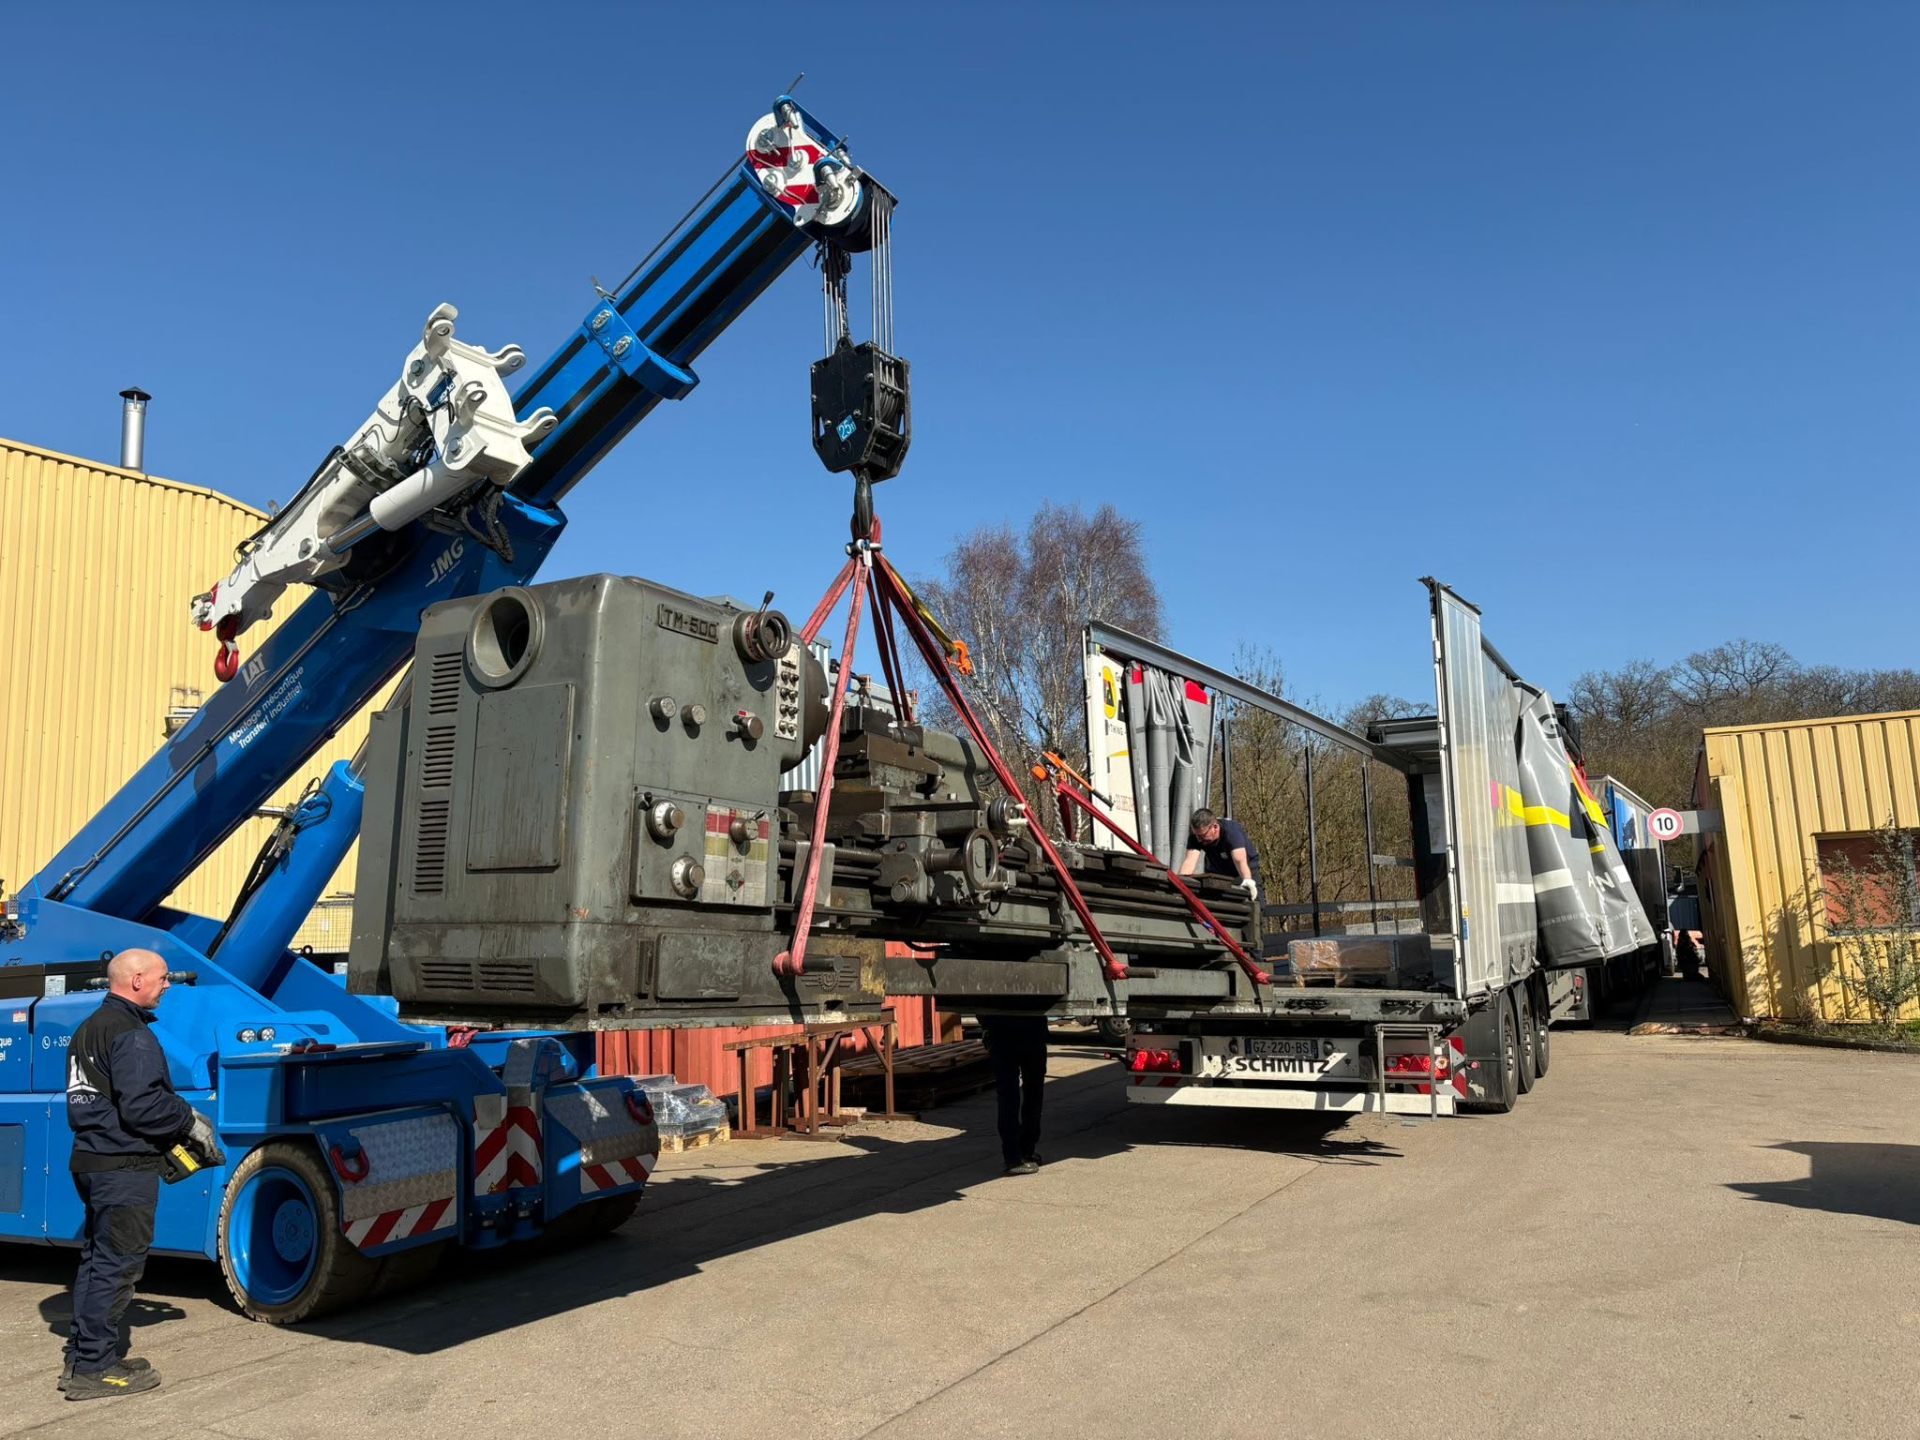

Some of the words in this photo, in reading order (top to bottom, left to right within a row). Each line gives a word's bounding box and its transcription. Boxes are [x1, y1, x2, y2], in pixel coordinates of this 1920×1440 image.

[663, 608, 718, 640] TM-500
[241, 652, 266, 687] LAT
[228, 709, 262, 745] Montage
[261, 665, 304, 712] mécanique
[238, 713, 270, 749] Transfert
[1656, 816, 1674, 832] 10
[1252, 1041, 1310, 1054] GZ-220-BS
[1235, 1057, 1331, 1074] SCHMITZ
